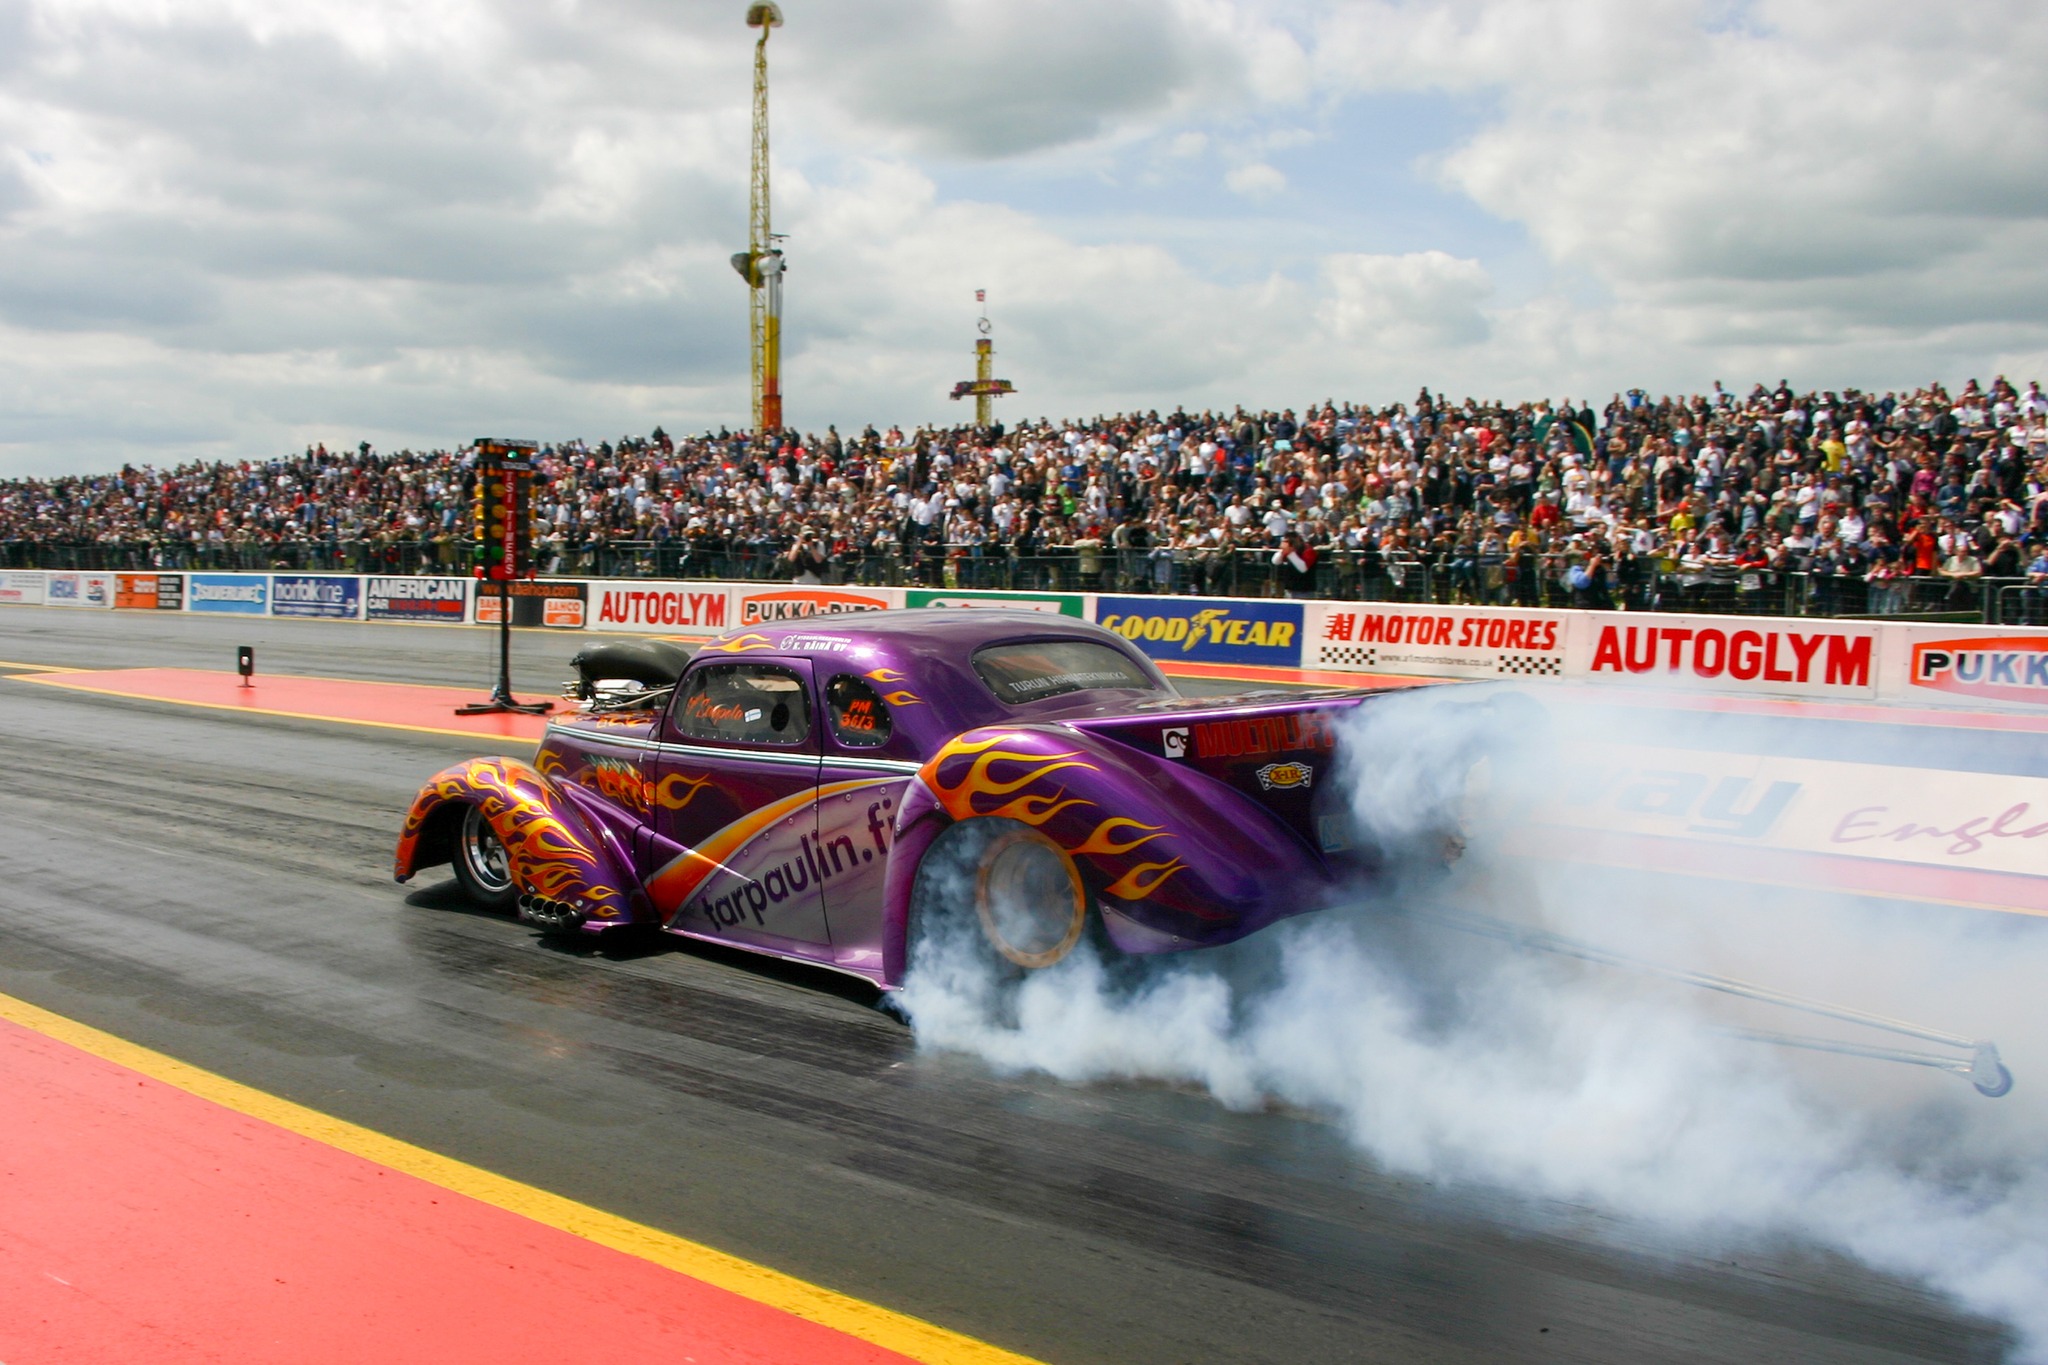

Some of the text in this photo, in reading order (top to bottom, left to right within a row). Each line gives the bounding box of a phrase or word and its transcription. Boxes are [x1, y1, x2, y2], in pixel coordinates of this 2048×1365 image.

[504, 510, 515, 574] TIMERS
[368, 579, 464, 600] AMERICAN
[368, 599, 389, 610] CAR
[547, 601, 581, 612] BAHCO
[599, 591, 726, 627] AUTOGLYM
[746, 601, 880, 620] PUKKA-PI
[1359, 614, 1455, 646] MOTOR
[1458, 617, 1558, 651] STORES
[1590, 625, 1873, 687] AUTOGLYM
[1008, 677, 1050, 692] TURUN
[849, 700, 873, 714] PM
[1194, 713, 1334, 757] MULTILIFT
